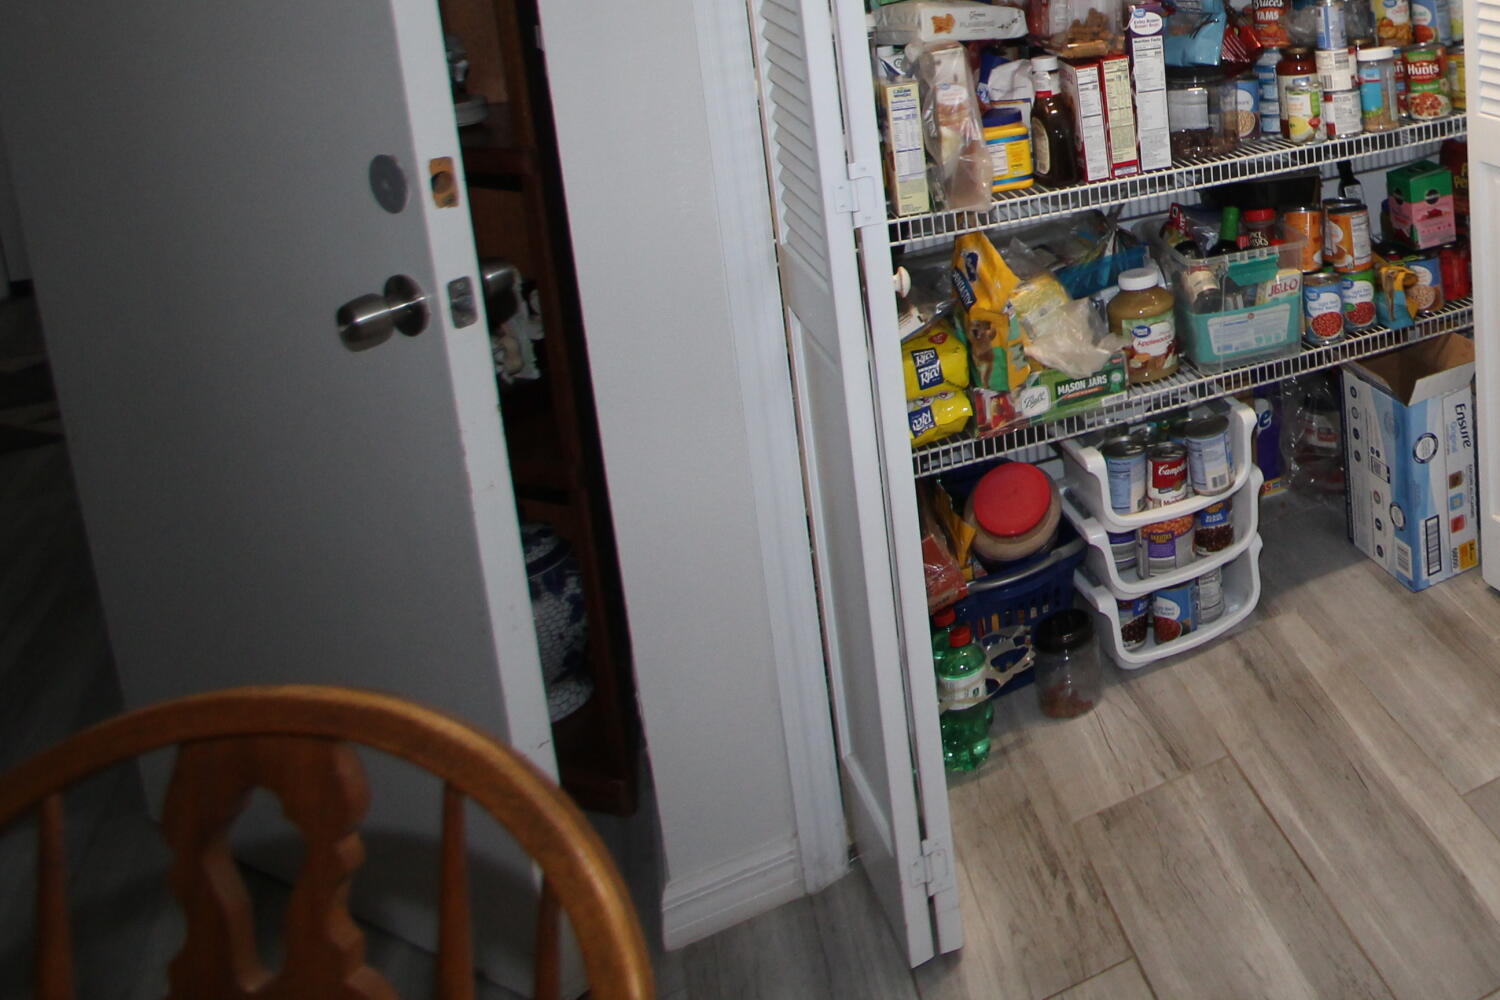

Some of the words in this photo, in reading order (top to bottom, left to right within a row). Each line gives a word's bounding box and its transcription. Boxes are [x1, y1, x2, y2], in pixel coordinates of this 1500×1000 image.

[1256, 10, 1279, 21] YAMS
[1057, 379, 1087, 397] MASON
[1087, 373, 1108, 389] JARS
[1455, 403, 1472, 448] Ensure
